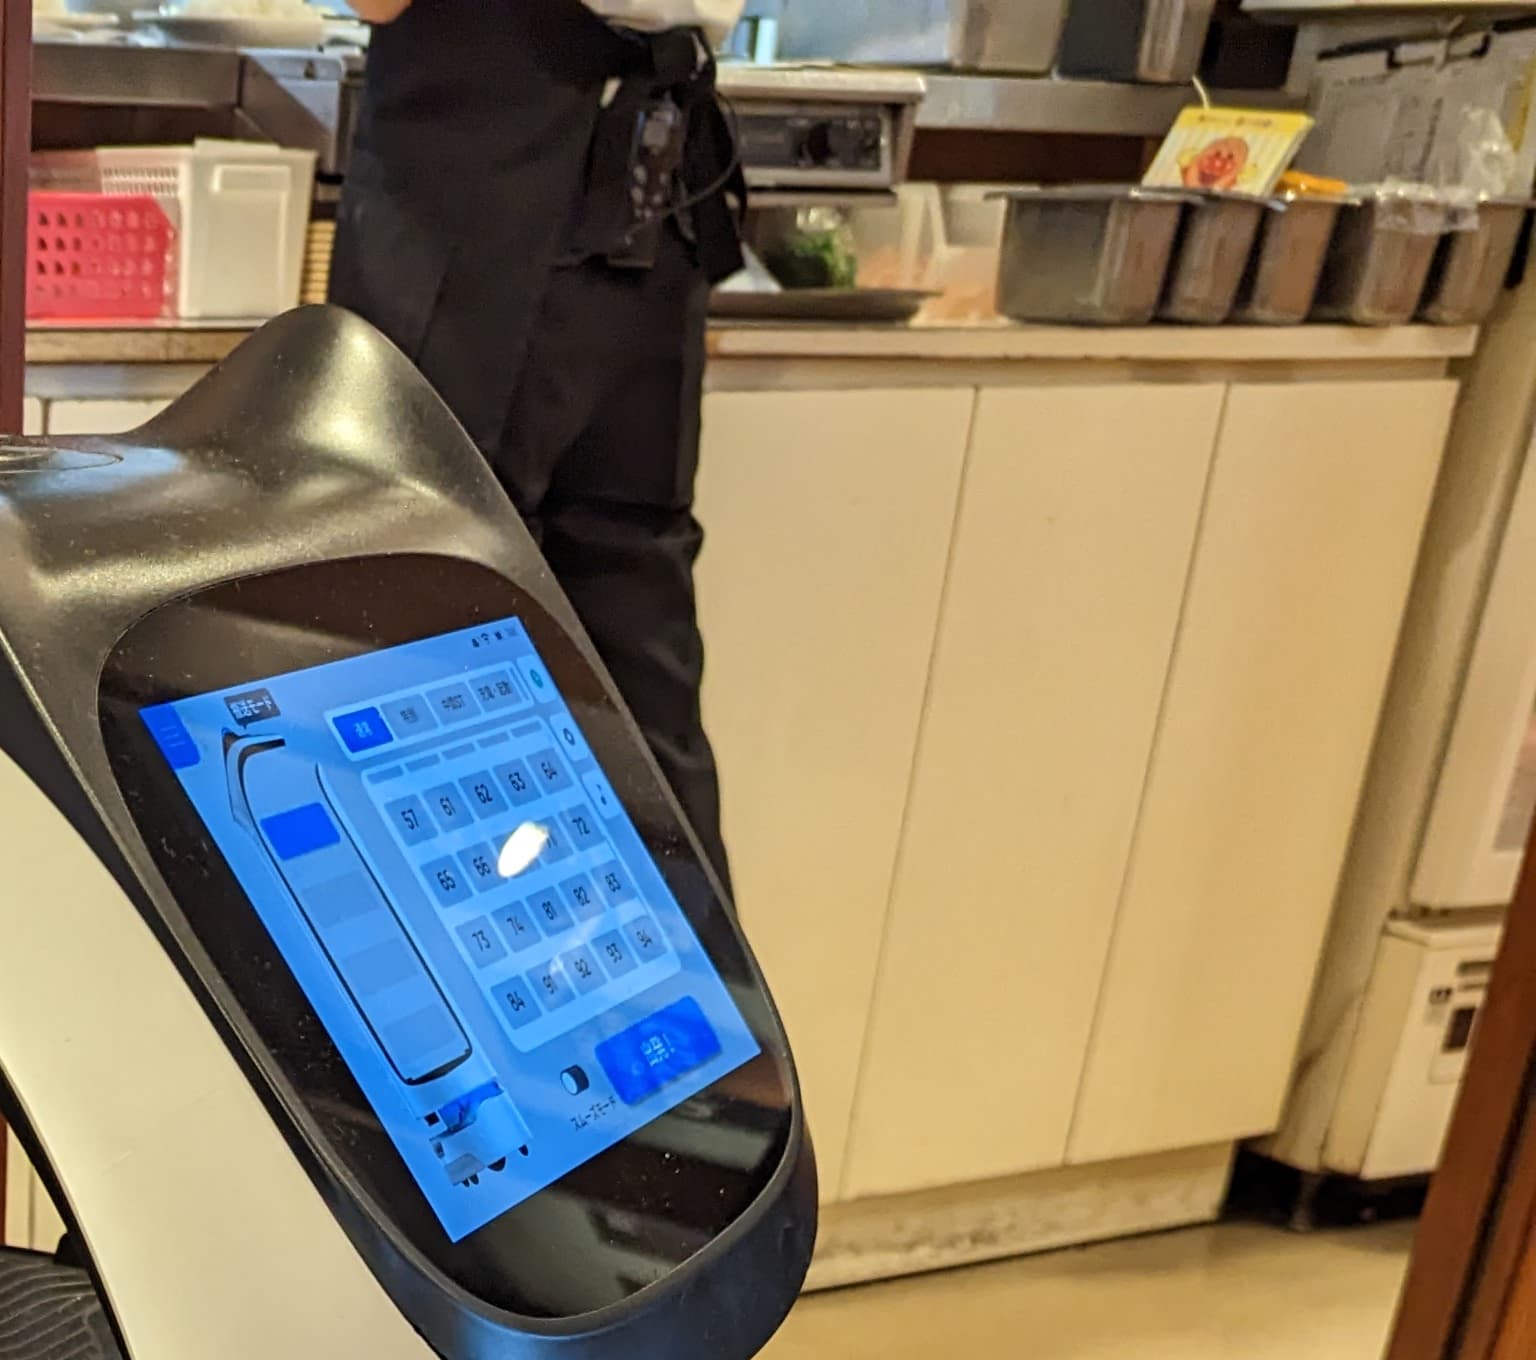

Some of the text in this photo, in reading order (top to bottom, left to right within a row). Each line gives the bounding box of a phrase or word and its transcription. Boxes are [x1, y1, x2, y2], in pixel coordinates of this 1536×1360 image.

[400, 808, 420, 831] 57
[474, 783, 493, 804] 62
[507, 771, 526, 792] 63
[436, 869, 456, 891] 65
[572, 816, 590, 836] 72
[471, 929, 491, 952] 73
